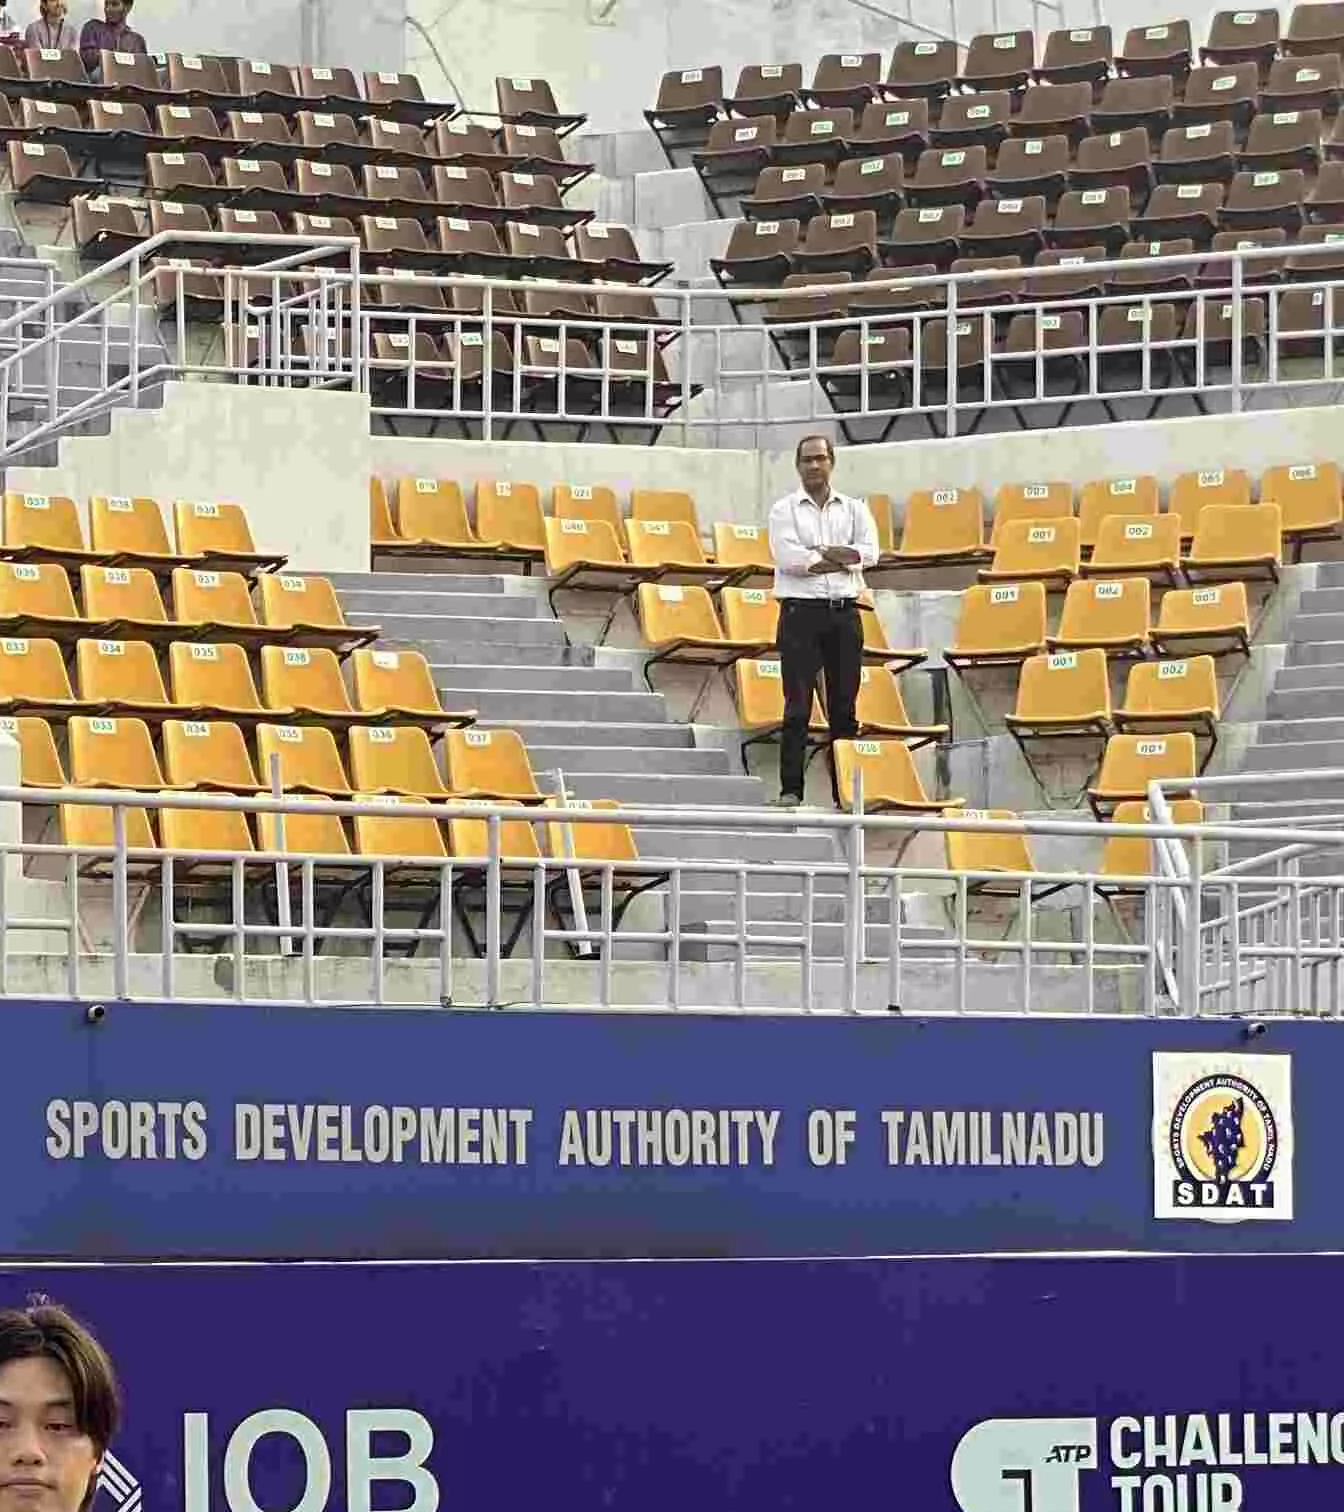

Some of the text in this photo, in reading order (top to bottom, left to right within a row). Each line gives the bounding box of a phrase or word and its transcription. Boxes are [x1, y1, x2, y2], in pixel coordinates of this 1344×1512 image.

[1162, 664, 1184, 675] 002
[47, 1100, 1103, 1166] SPORTS DEVELOPMENT AUTHORITY OF TAMILNADU
[1178, 1183, 1267, 1205] SDAT
[1045, 1445, 1092, 1464] ATP
